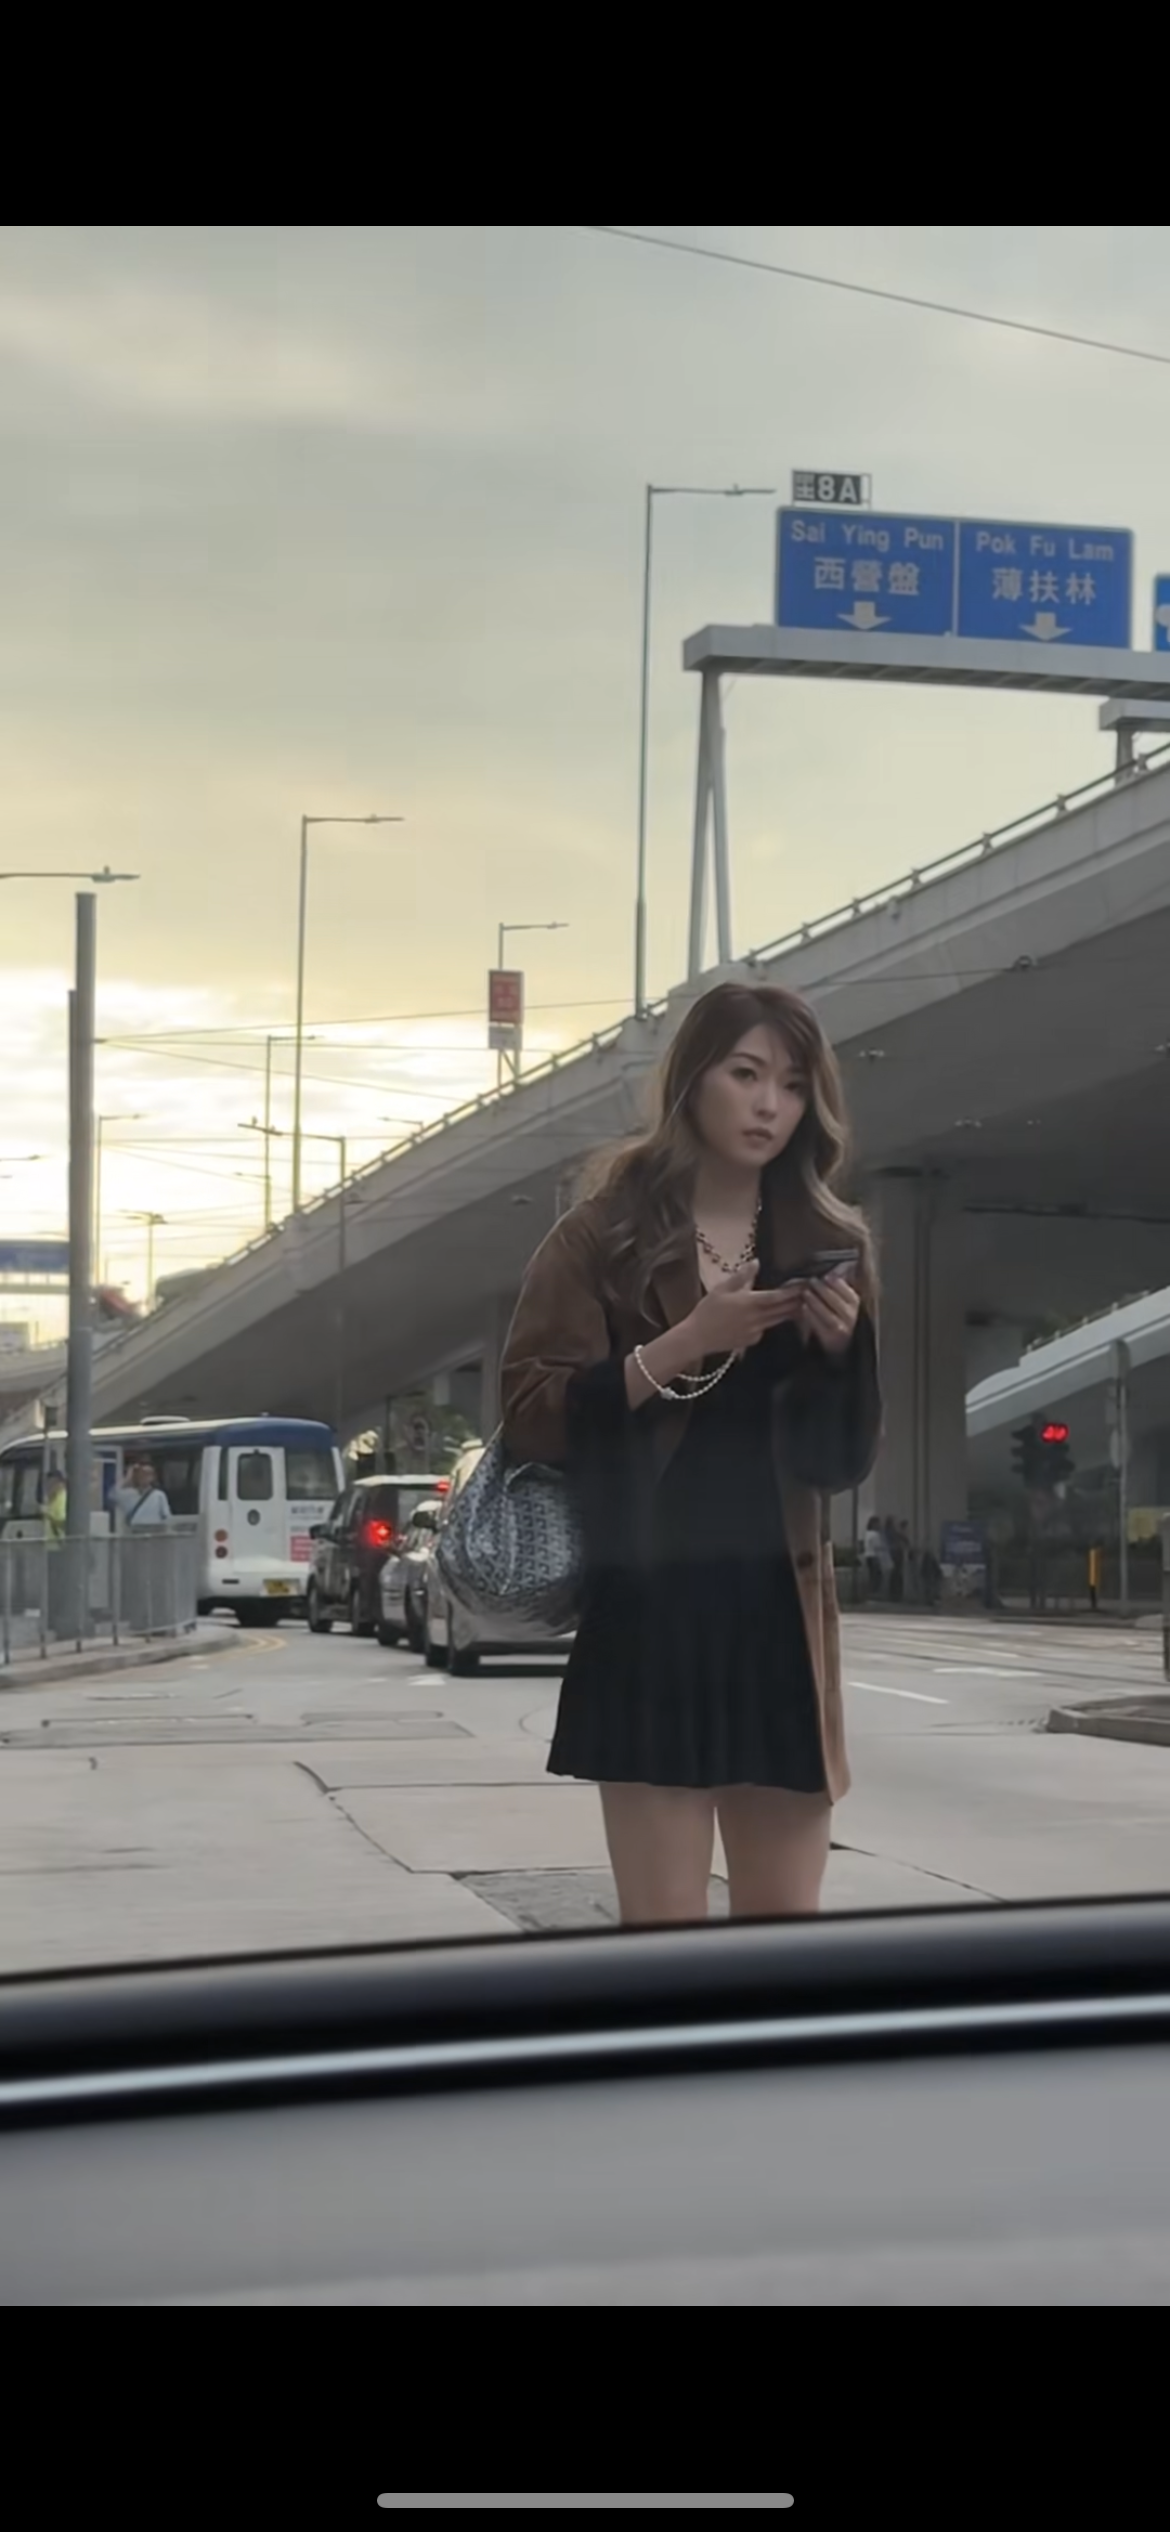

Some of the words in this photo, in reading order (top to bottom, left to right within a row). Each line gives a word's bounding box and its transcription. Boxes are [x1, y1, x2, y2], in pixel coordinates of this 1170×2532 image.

[818, 475, 858, 503] 8A
[791, 519, 826, 543] Sai
[842, 524, 889, 552] Ying
[904, 527, 944, 550] Pun
[976, 531, 1016, 554] Pok
[1030, 535, 1055, 557] Fu
[1069, 538, 1114, 561] Lam
[814, 557, 920, 596] 西營盤
[992, 567, 1096, 605] 薄扶林
